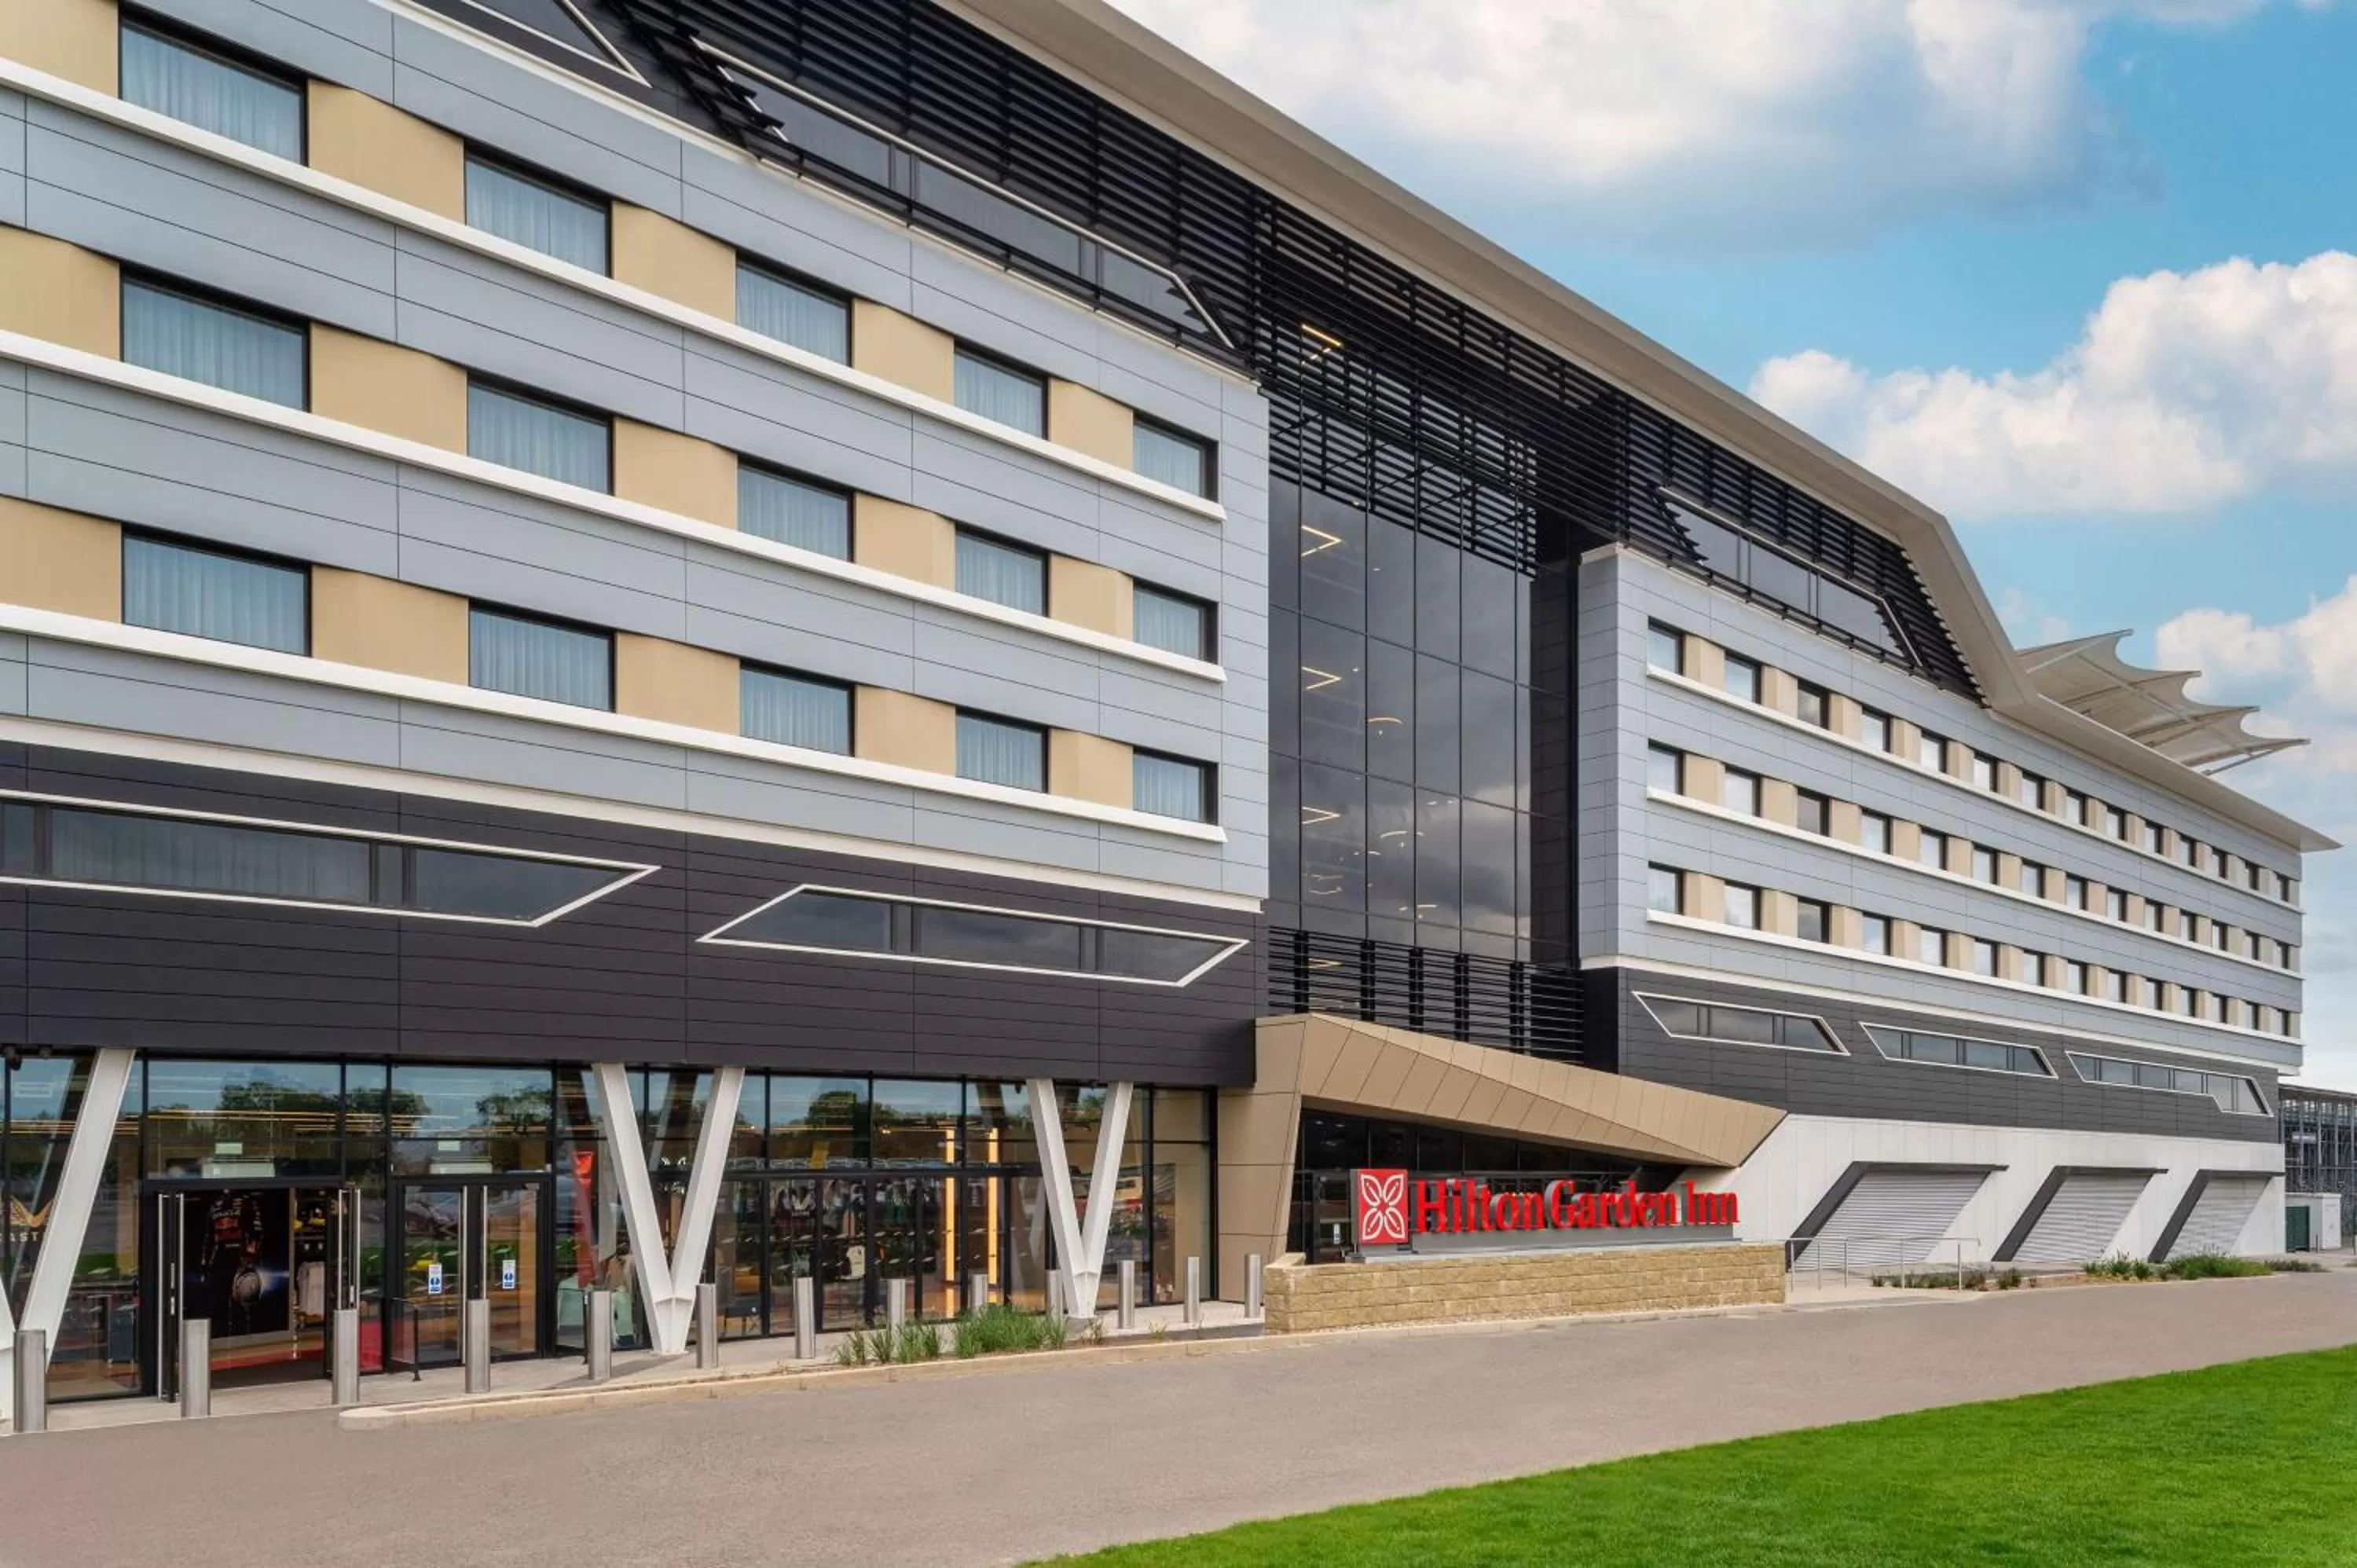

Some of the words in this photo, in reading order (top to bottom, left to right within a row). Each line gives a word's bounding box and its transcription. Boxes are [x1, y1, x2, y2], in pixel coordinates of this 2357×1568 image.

[1415, 1178, 1547, 1232] Hilton
[1549, 1178, 1677, 1229] Garden
[1684, 1179, 1740, 1225] Inn
[0, 1231, 39, 1243] AST
